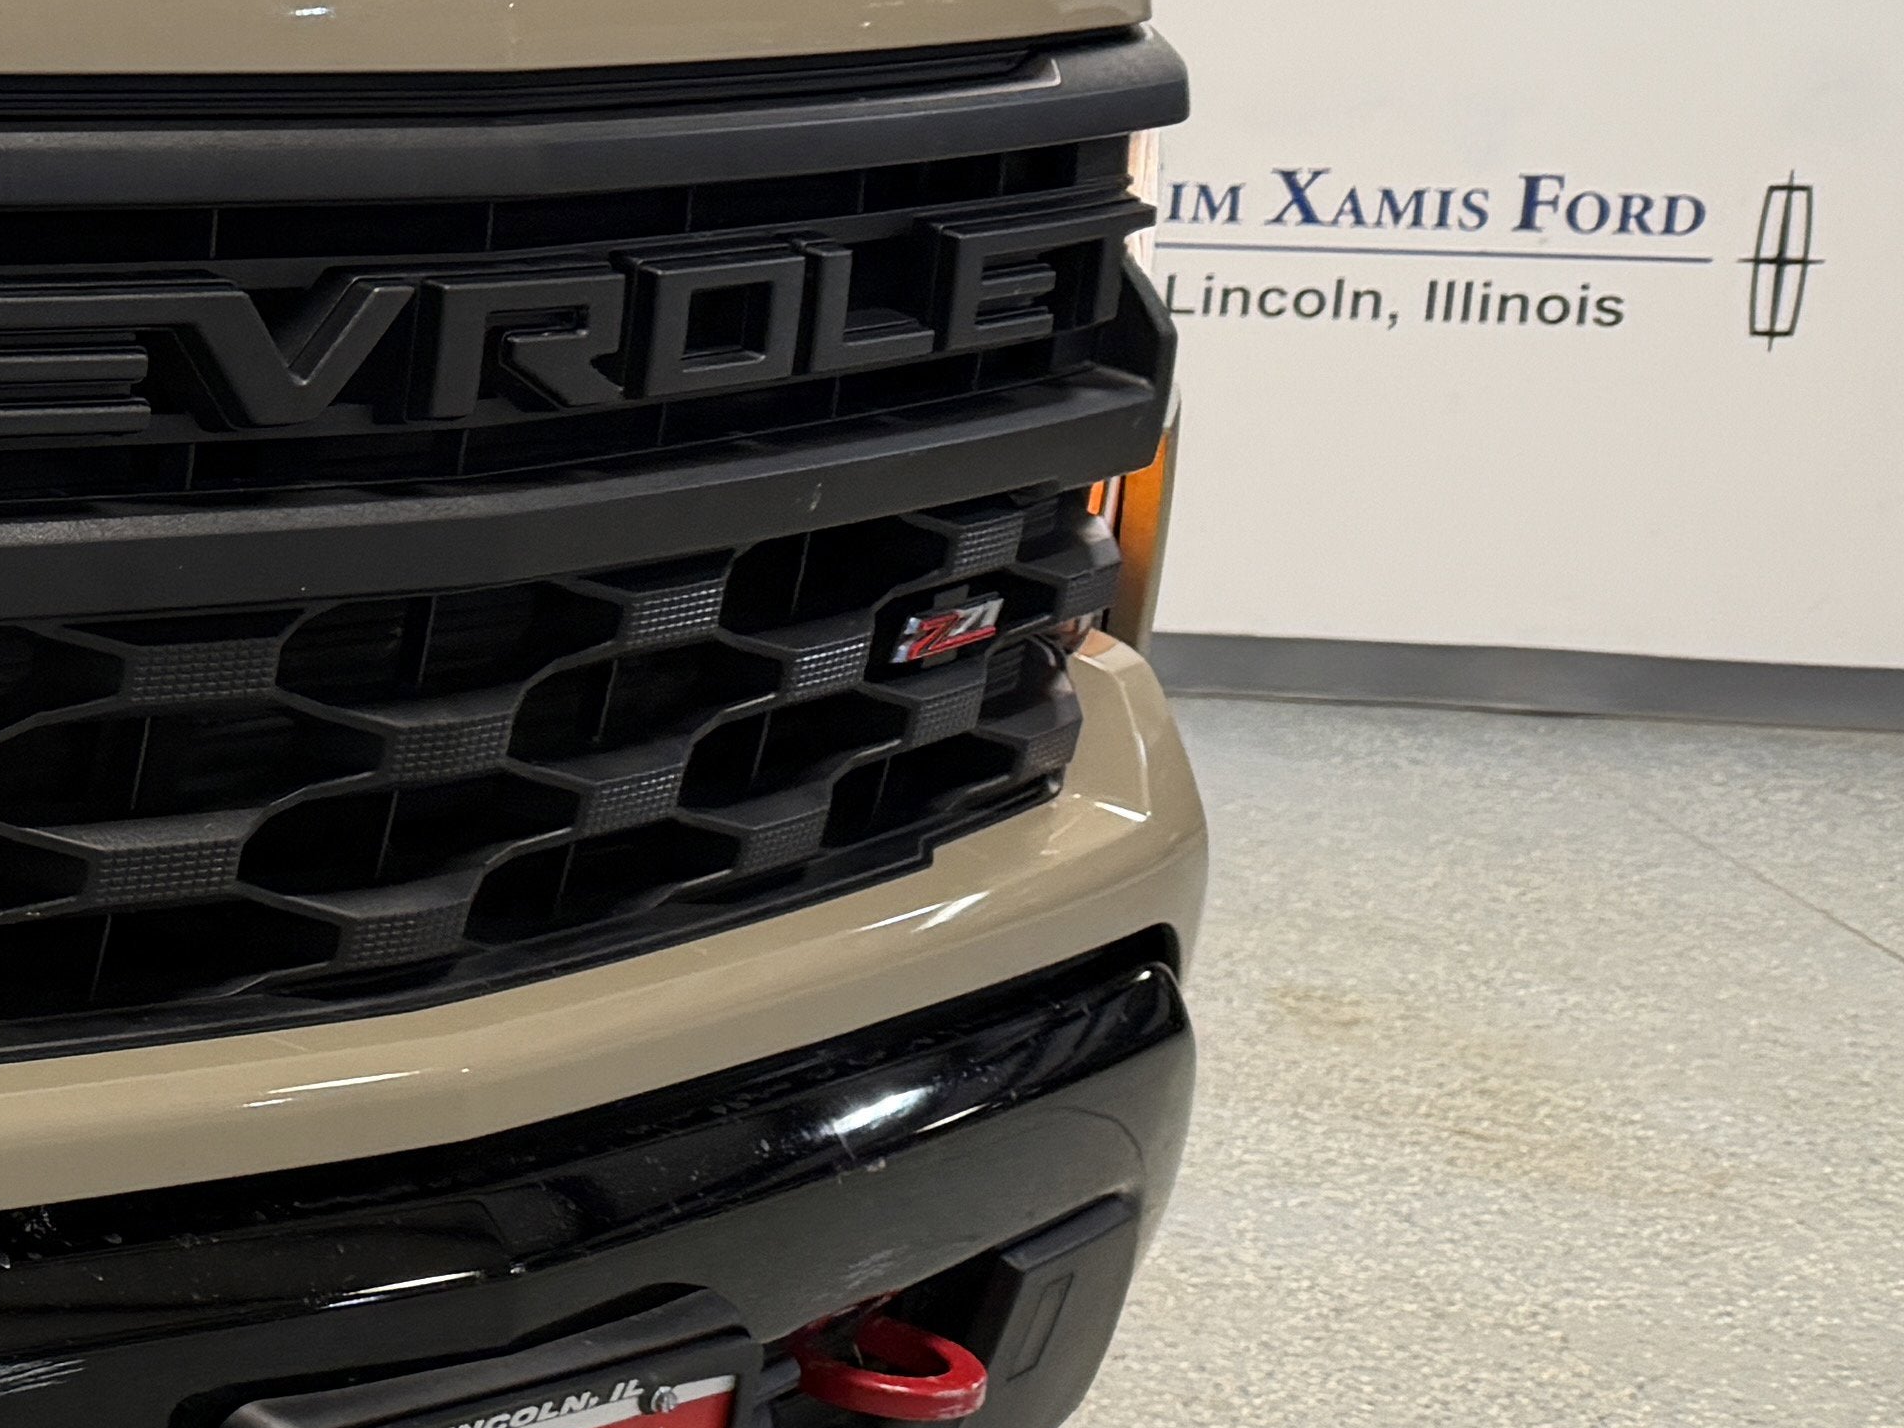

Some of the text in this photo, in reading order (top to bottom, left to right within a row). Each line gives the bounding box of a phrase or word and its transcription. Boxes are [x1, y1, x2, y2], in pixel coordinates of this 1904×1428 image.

[1164, 167, 1708, 237] IM XAMIS FORD
[1165, 273, 1626, 331] Lincoln, Illinois
